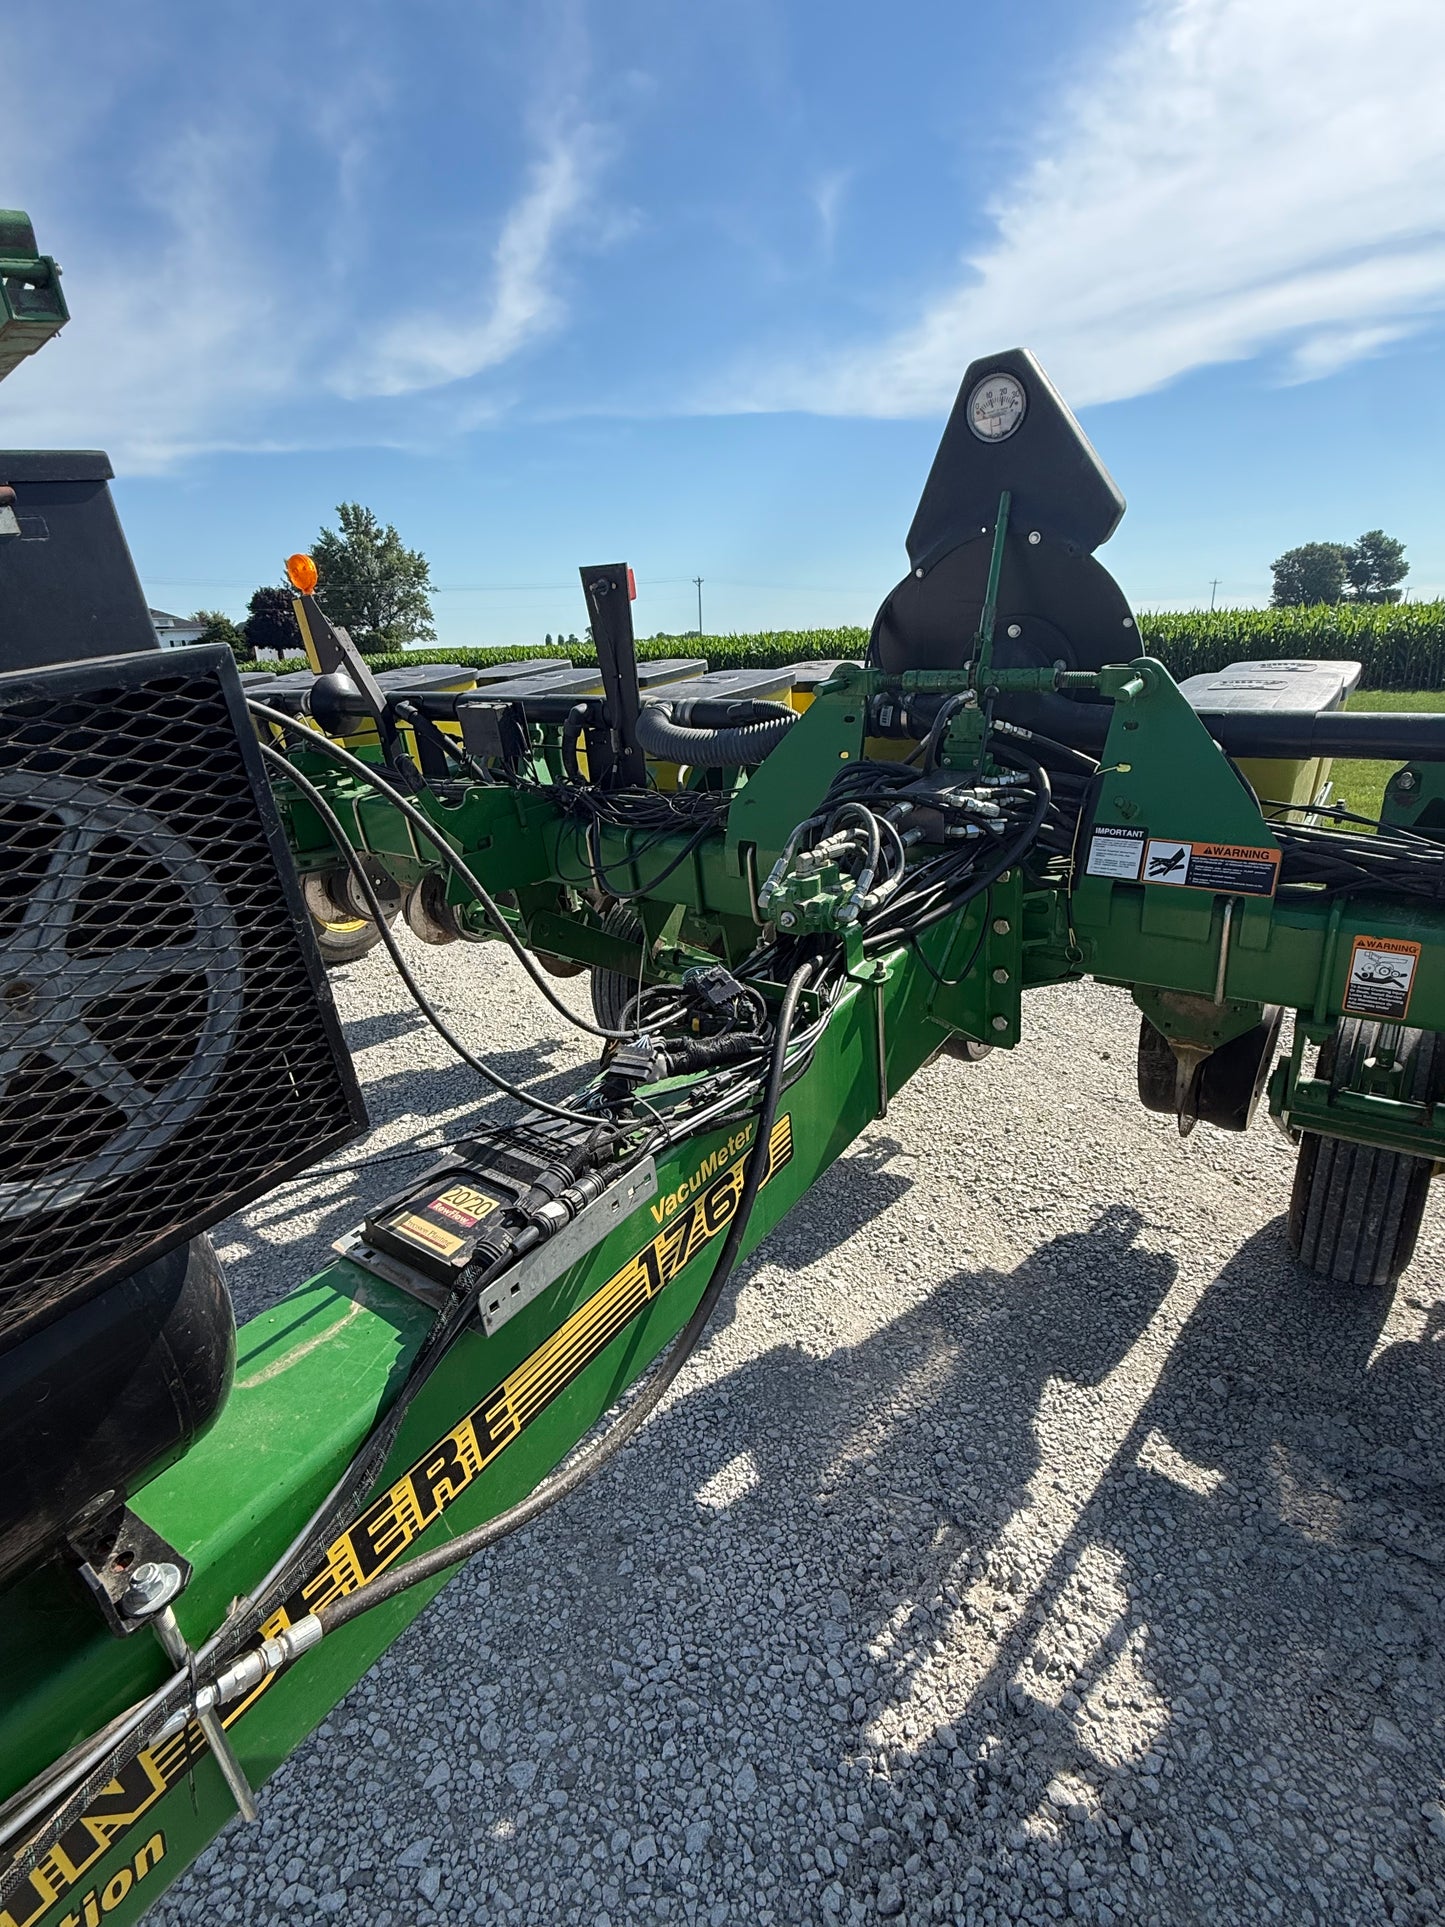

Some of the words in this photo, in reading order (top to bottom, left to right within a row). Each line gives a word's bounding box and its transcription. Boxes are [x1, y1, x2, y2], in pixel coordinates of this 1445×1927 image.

[1095, 827, 1144, 838] IMPORTANT
[1213, 846, 1270, 860] WARNING
[1367, 940, 1417, 954] WARNING
[650, 1123, 753, 1224] VacuMeter
[443, 1187, 493, 1216] 20/20
